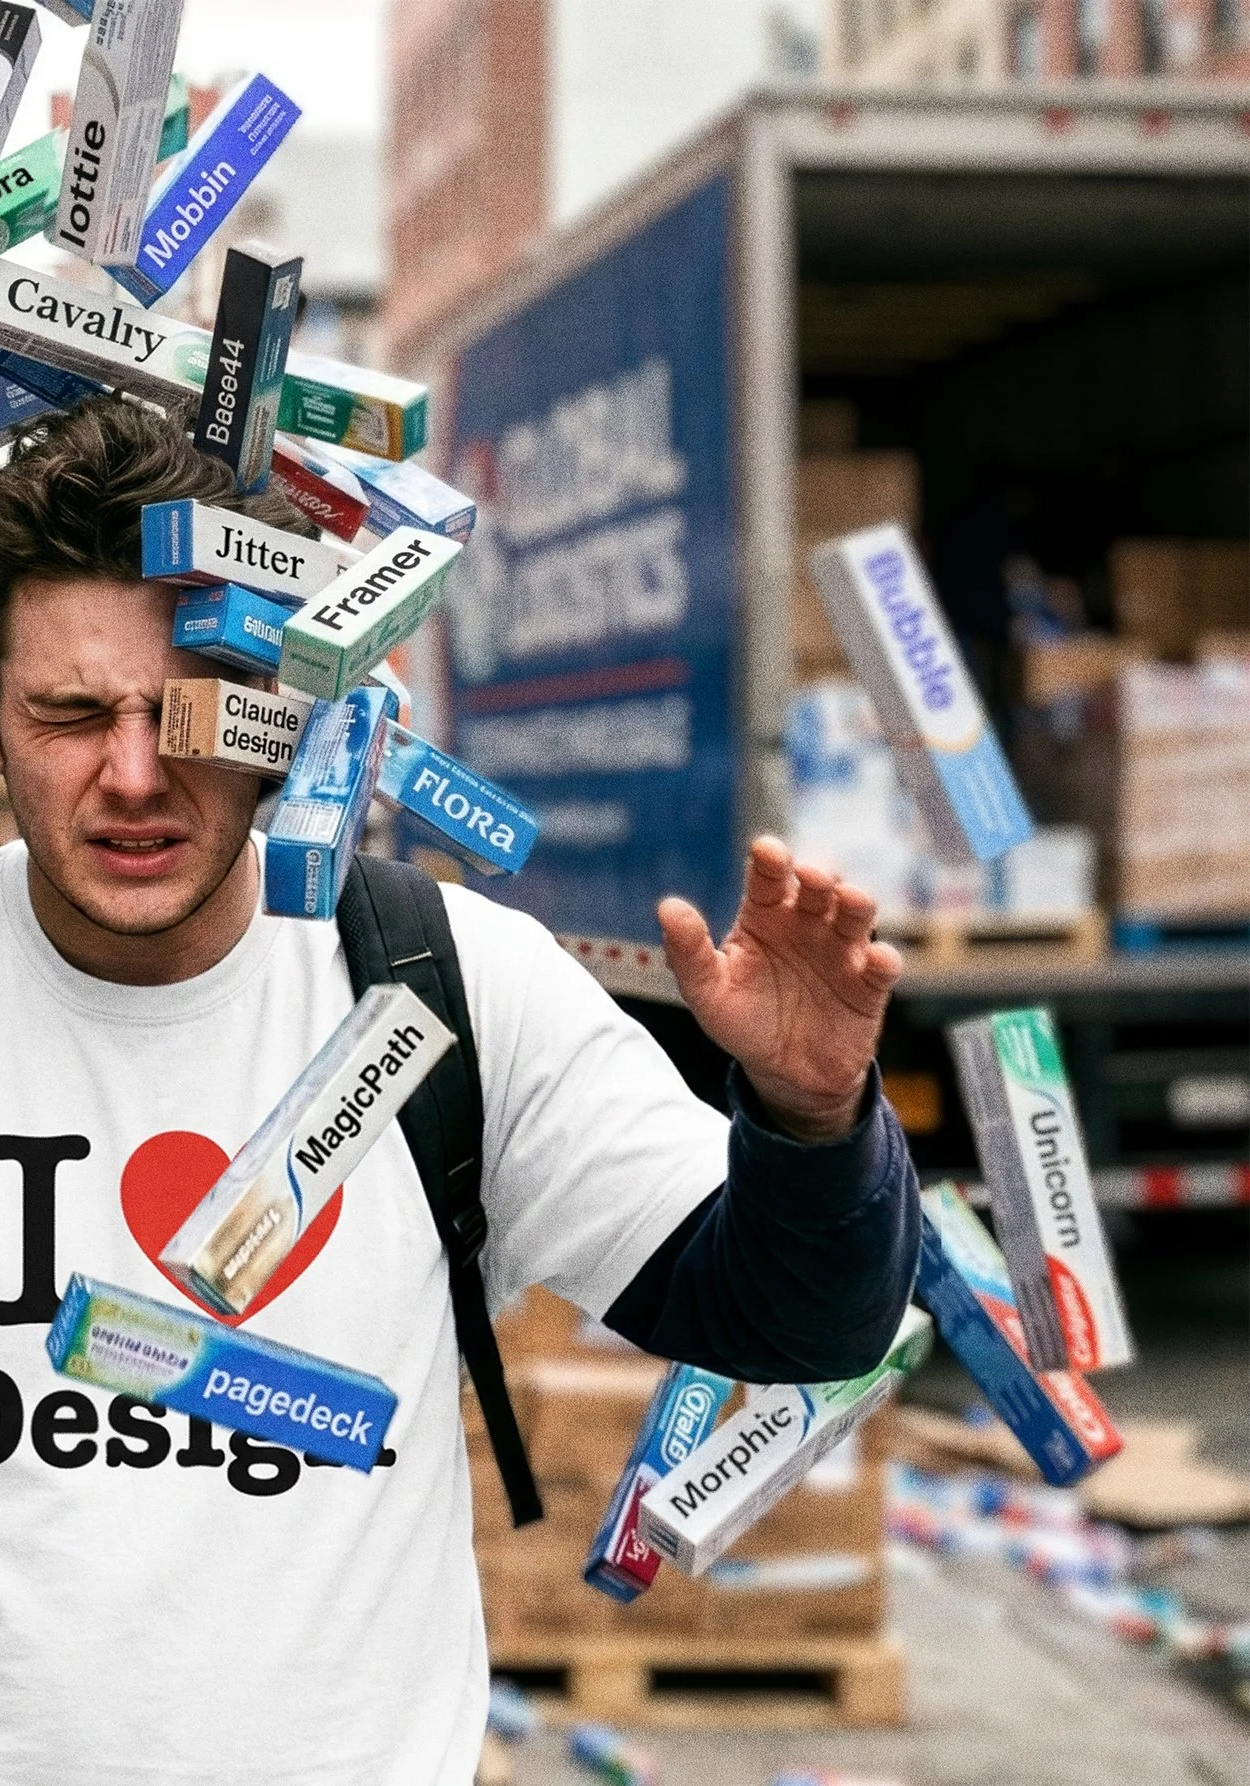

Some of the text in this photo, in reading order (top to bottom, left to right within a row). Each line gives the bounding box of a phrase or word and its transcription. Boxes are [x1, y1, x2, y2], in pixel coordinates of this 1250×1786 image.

[60, 121, 105, 247] lottie
[143, 159, 237, 270] Mobbin
[7, 277, 167, 363] Cavalry
[206, 339, 244, 445] Base44
[215, 525, 305, 579] Jitter
[311, 539, 433, 631] Framer
[222, 726, 294, 763] design
[224, 694, 299, 732] Claude
[295, 1022, 424, 1173] MagicPath
[1030, 1111, 1080, 1249] Unicorn
[204, 1364, 371, 1445] pagedeck
[668, 1405, 793, 1518] Morphic
